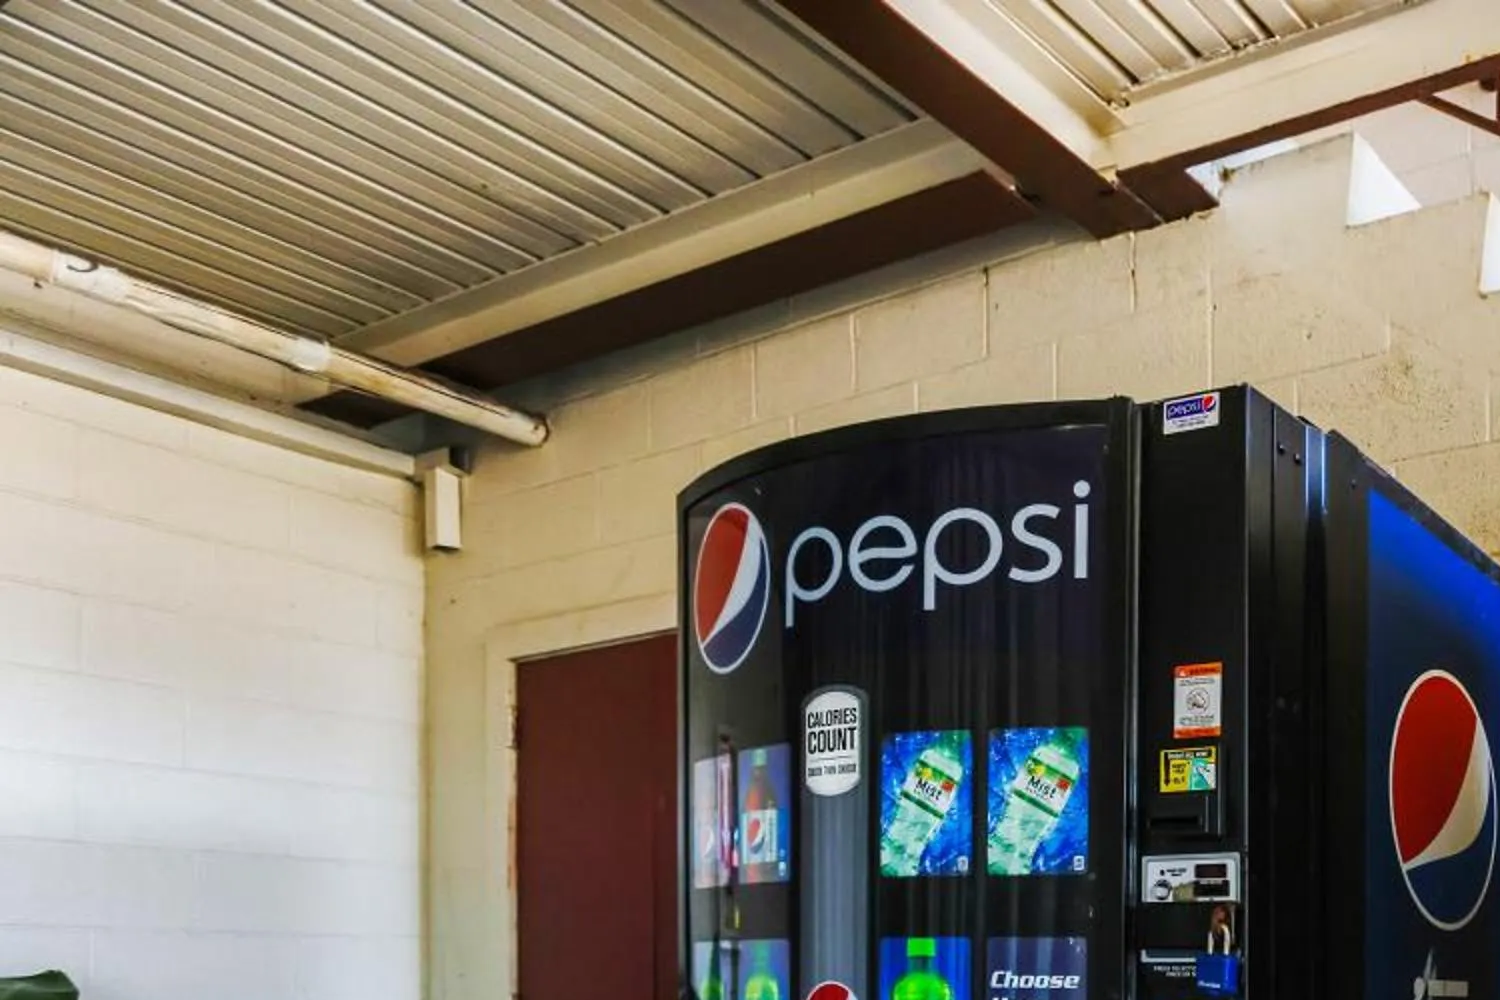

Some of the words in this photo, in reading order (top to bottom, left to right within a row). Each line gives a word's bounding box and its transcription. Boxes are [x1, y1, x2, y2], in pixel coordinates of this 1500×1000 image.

[1166, 399, 1203, 420] pepsi
[785, 479, 1091, 628] pepsi
[808, 707, 857, 729] CALORIES
[808, 726, 857, 755] COUNT
[915, 778, 943, 801] Mist
[1027, 776, 1056, 799] Mist
[990, 970, 1081, 989] Choose
